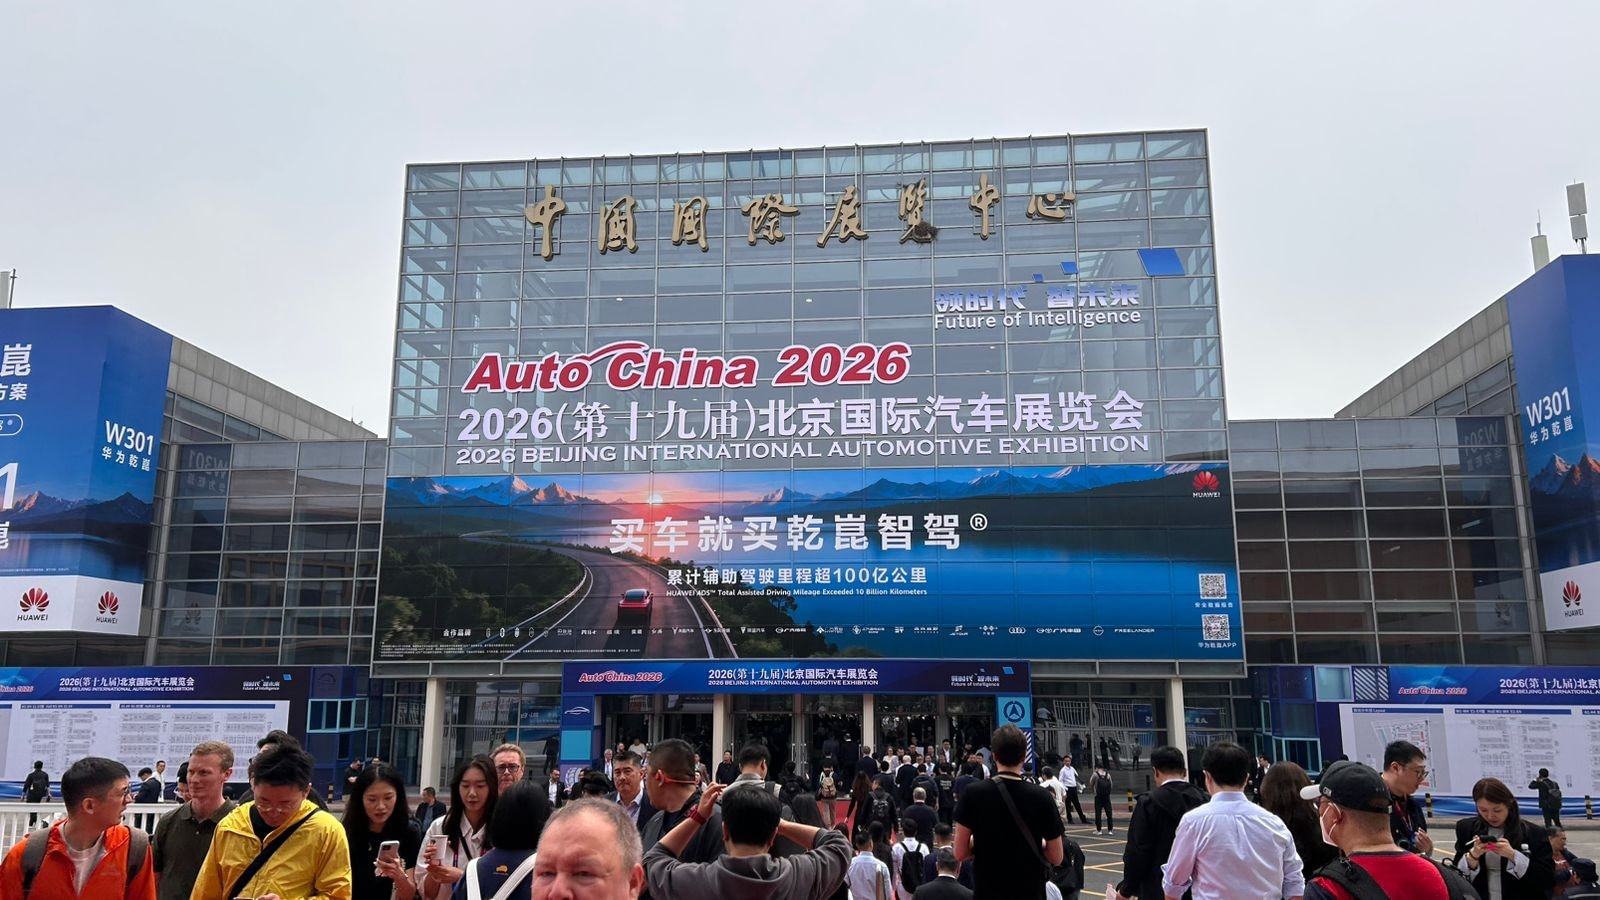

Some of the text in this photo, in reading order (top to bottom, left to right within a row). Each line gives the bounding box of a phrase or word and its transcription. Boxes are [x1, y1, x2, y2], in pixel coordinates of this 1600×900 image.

[935, 283, 1139, 313] 领时代 智未来
[935, 309, 1141, 330] Future of Intelligence
[461, 342, 912, 393] Auto China 2026
[457, 390, 1145, 444] 2026(第十九届)北京国际汽车展览会
[1526, 386, 1571, 427] W301
[105, 420, 154, 456] W301
[101, 446, 151, 472] 华为乾崑
[456, 435, 1149, 465] 2026 BEIJING INTERNATIONAL AUTOMOTIVE EXHIBITION
[666, 567, 927, 586] 累计辅助驾驶里程超100亿公里
[666, 589, 695, 597] HUAWEI
[766, 589, 791, 597] Driving
[793, 588, 821, 597] Mileage
[17, 614, 49, 622] HUAWEI
[95, 616, 118, 625] HUAWEI
[578, 670, 663, 682] Auto China 2026
[1499, 677, 1600, 689] 2026(第十九届)北京
